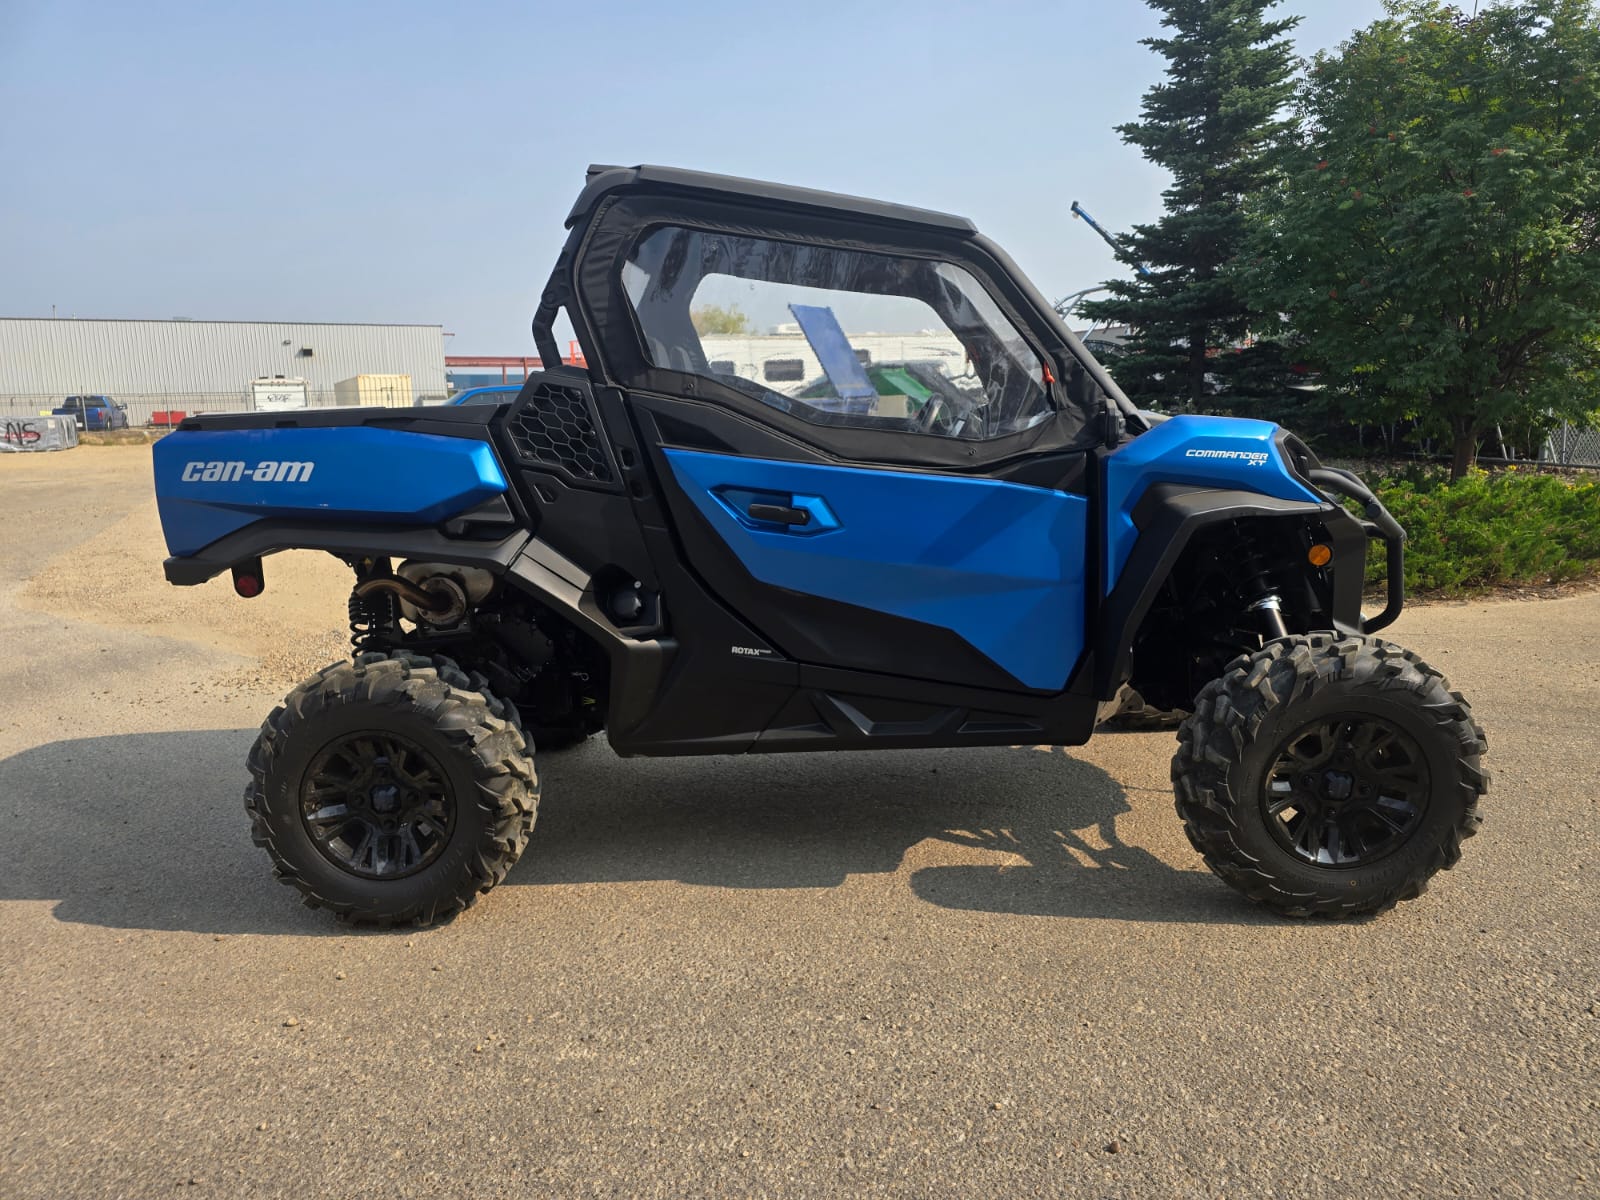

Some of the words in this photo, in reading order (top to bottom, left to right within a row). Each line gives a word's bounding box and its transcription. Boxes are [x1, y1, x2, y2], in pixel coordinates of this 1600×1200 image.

[6, 422, 41, 446] NS
[1185, 449, 1269, 460] COMMANDER
[181, 461, 315, 482] can-am
[731, 646, 760, 656] ROTAX
